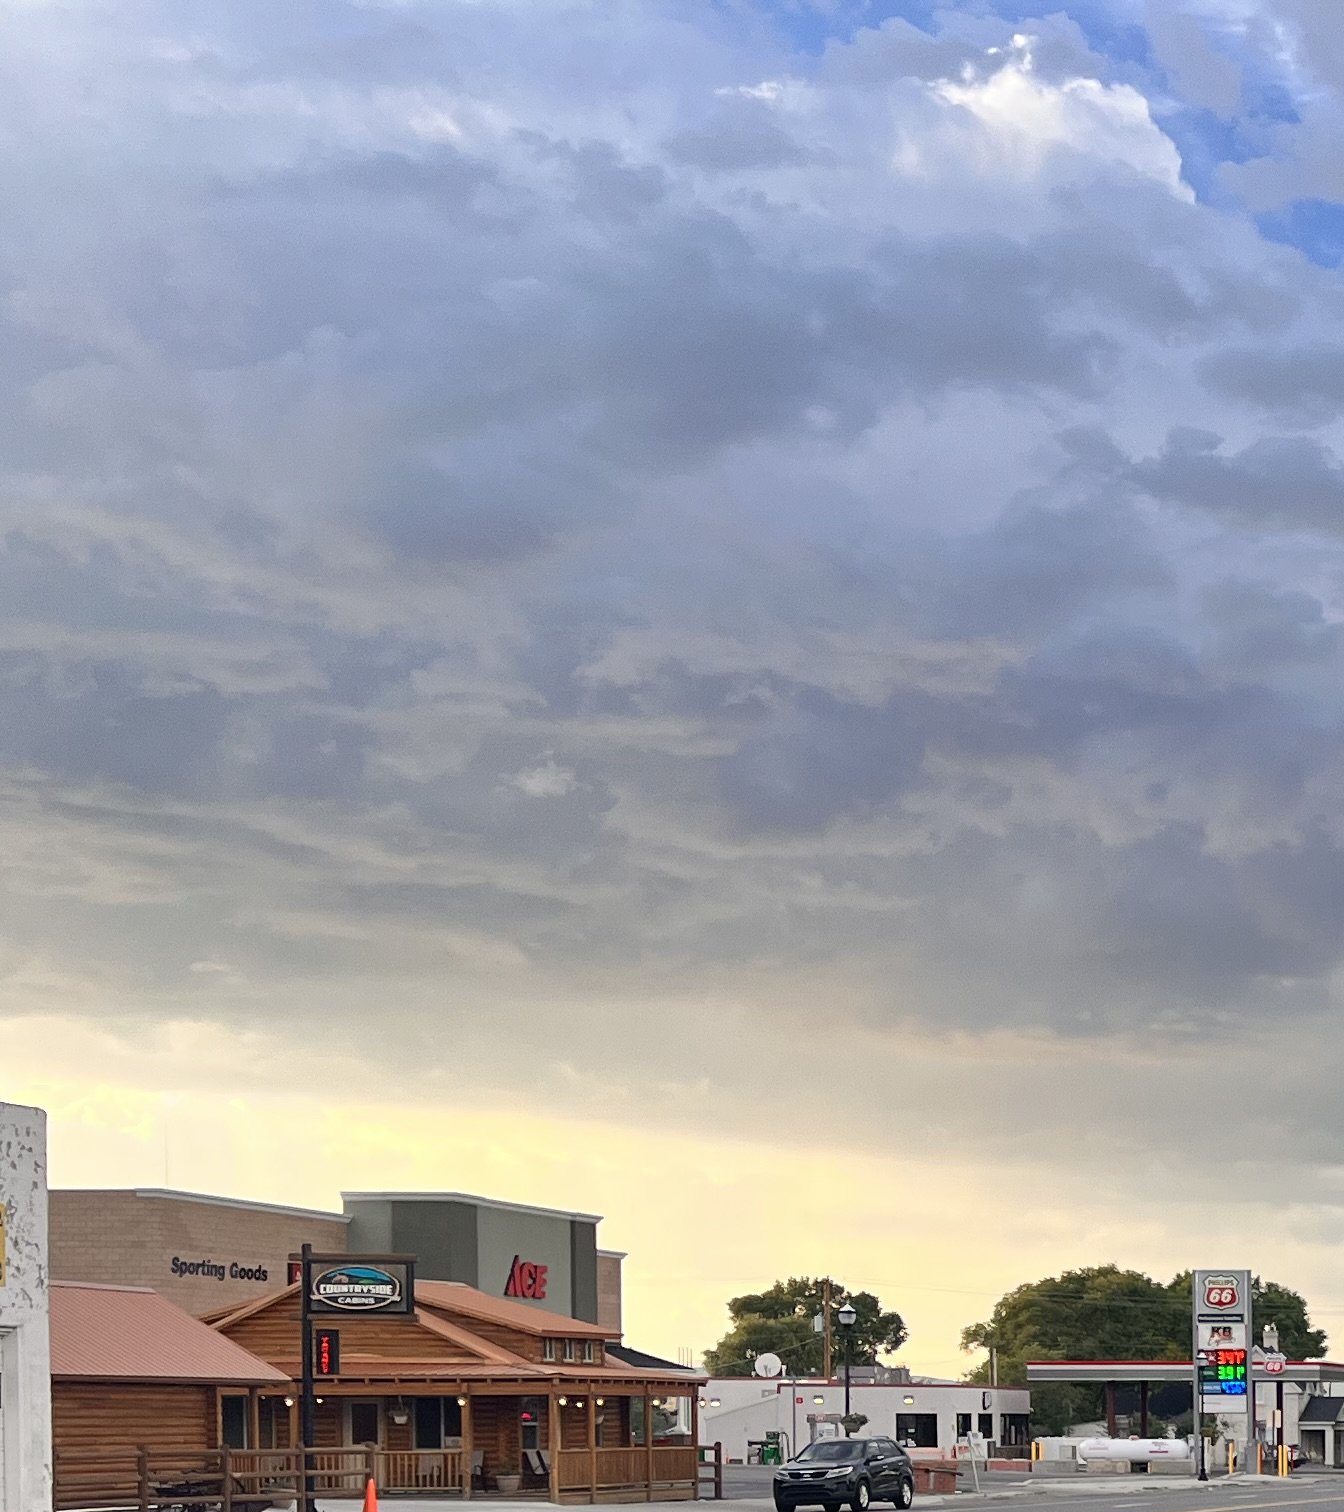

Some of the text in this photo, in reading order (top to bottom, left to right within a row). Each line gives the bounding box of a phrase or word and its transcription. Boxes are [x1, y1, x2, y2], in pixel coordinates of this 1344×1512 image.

[171, 1256, 268, 1281] Sporting Goods
[504, 1254, 548, 1299] ACE
[319, 1284, 393, 1295] COUNTRYSIDE
[1209, 1288, 1233, 1303] 66
